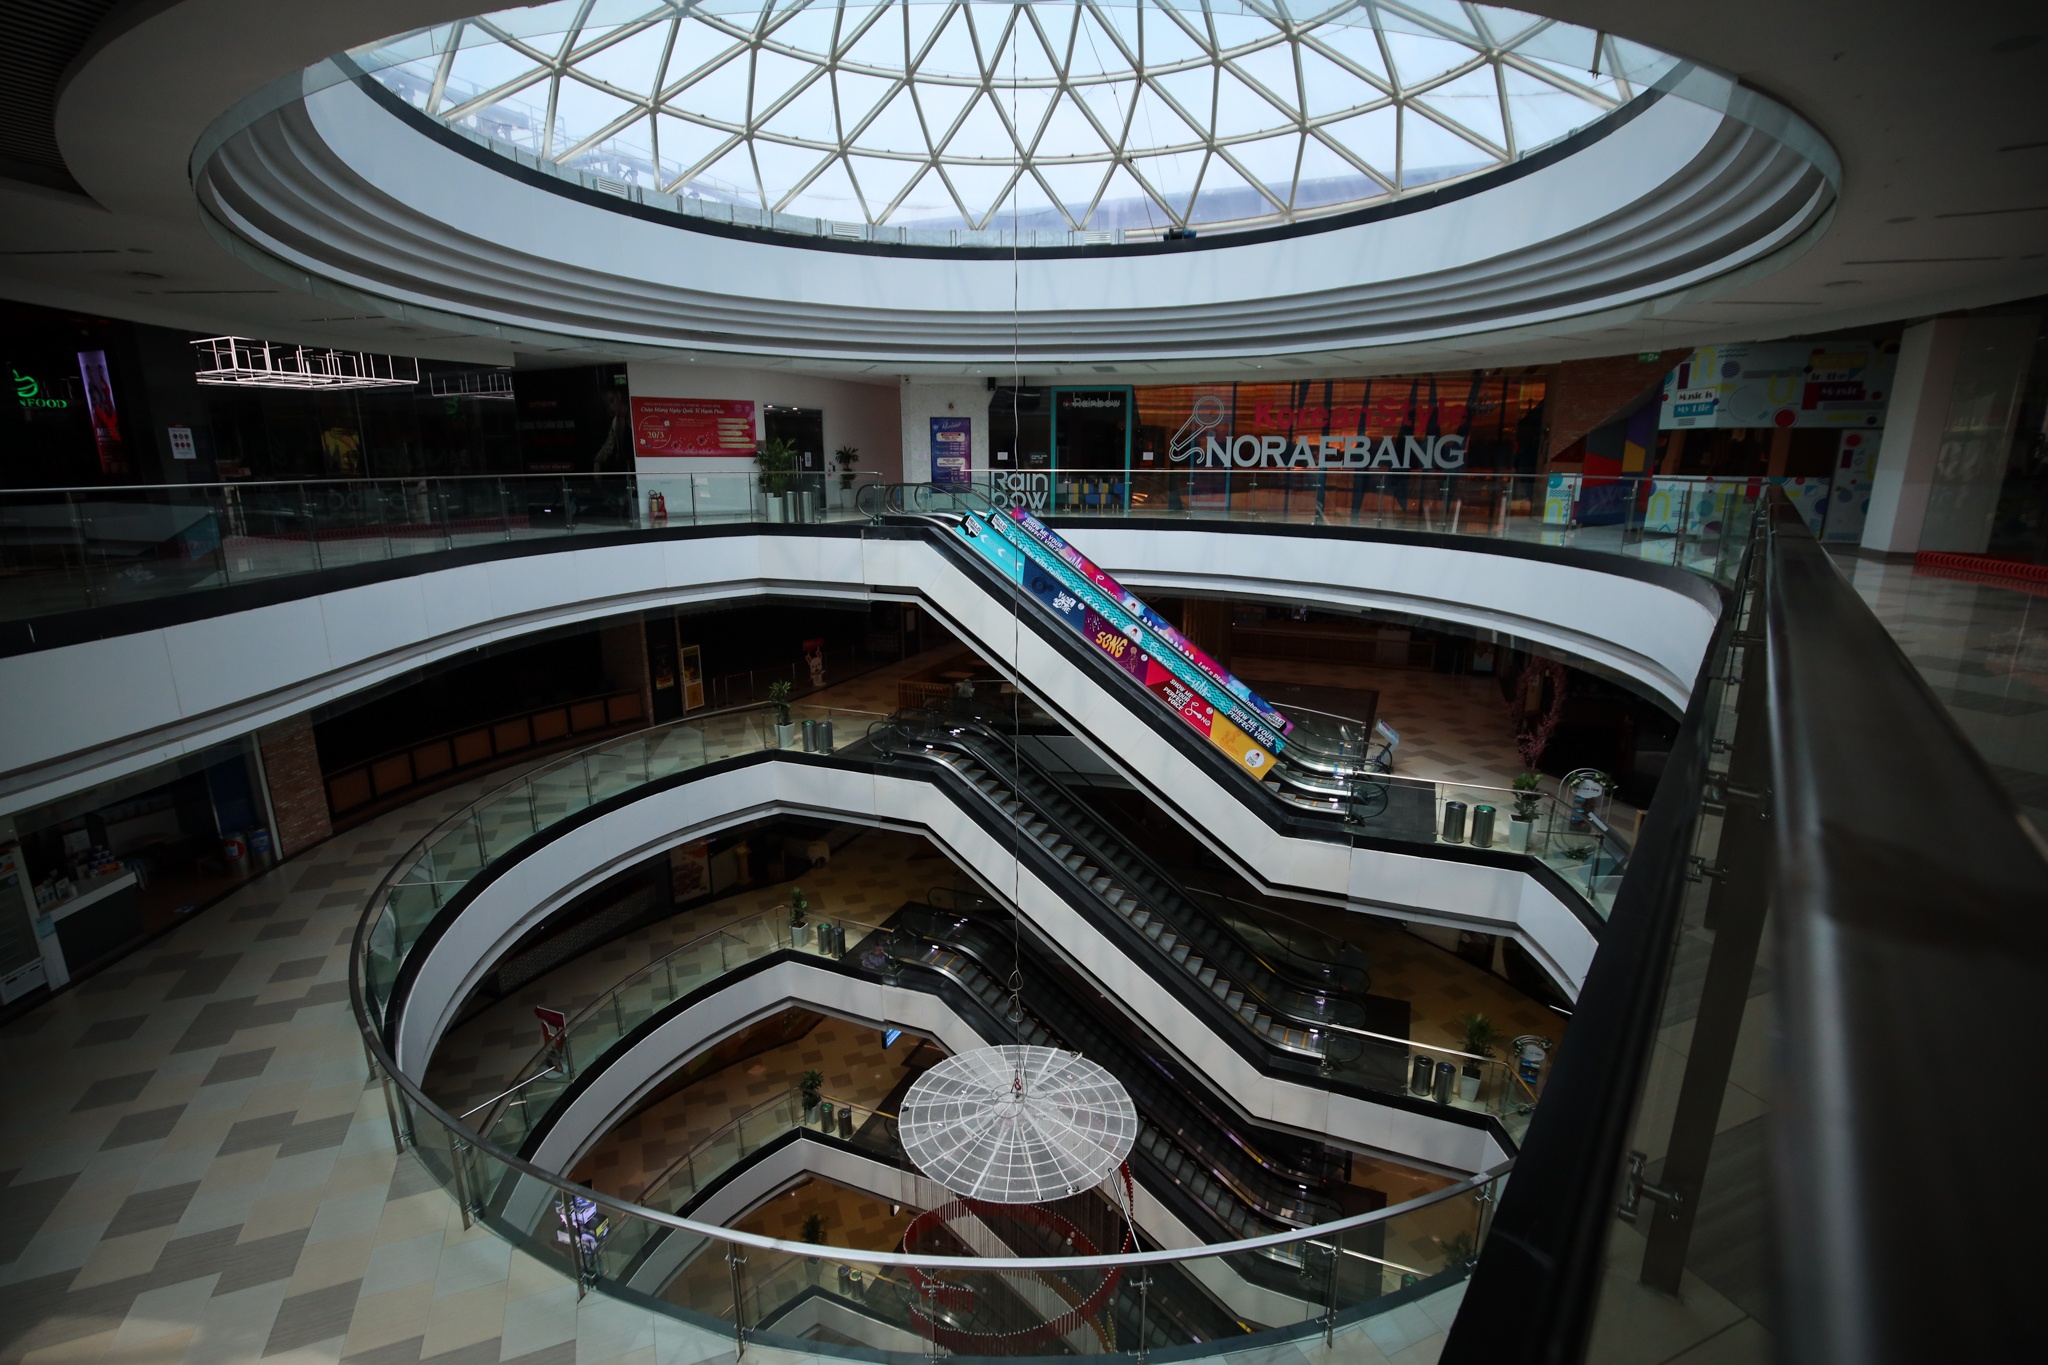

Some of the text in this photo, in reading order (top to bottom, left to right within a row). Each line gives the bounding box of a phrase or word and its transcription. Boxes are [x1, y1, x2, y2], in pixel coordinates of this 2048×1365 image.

[1073, 398, 1120, 408] Rainbow
[1254, 397, 1468, 433] Korean Style
[647, 431, 665, 439] 20/3
[1205, 434, 1466, 469] NORAEBANG
[991, 471, 1049, 491] Rain
[991, 491, 1049, 510] bow
[1026, 518, 1040, 530] SHOW
[1048, 535, 1063, 547] YOUR
[1096, 631, 1128, 658] SONG
[1198, 661, 1214, 675] Let's
[1163, 687, 1187, 705] PERFECT
[1170, 679, 1193, 698] SHOW ME
[1175, 690, 1190, 702] YOUR
[1167, 697, 1183, 710] VOICE
[1227, 710, 1273, 747] PERFECT VOICE
[1231, 705, 1275, 741] SHOW ME YOUR
